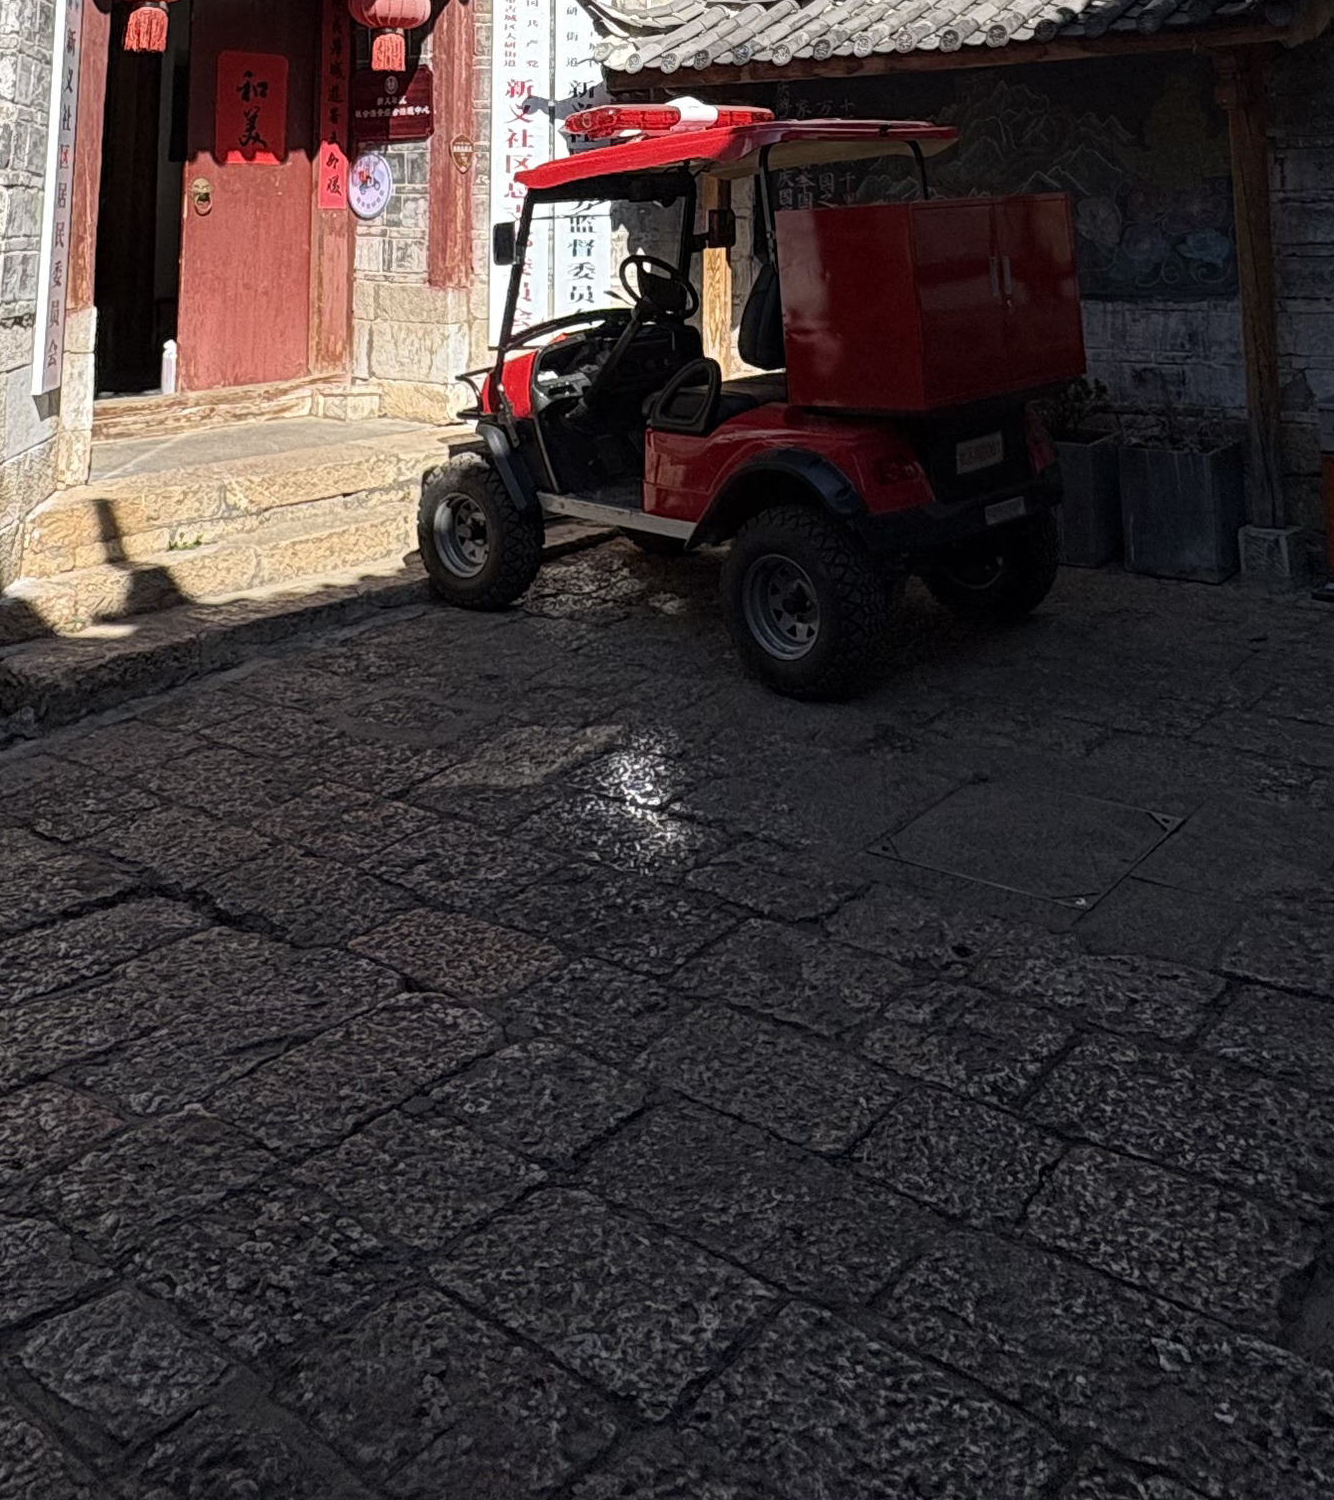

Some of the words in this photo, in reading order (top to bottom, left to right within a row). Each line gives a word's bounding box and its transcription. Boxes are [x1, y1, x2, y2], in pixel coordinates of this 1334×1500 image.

[48, 28, 76, 367] 新义社区居民委员会
[236, 71, 269, 149] 和美
